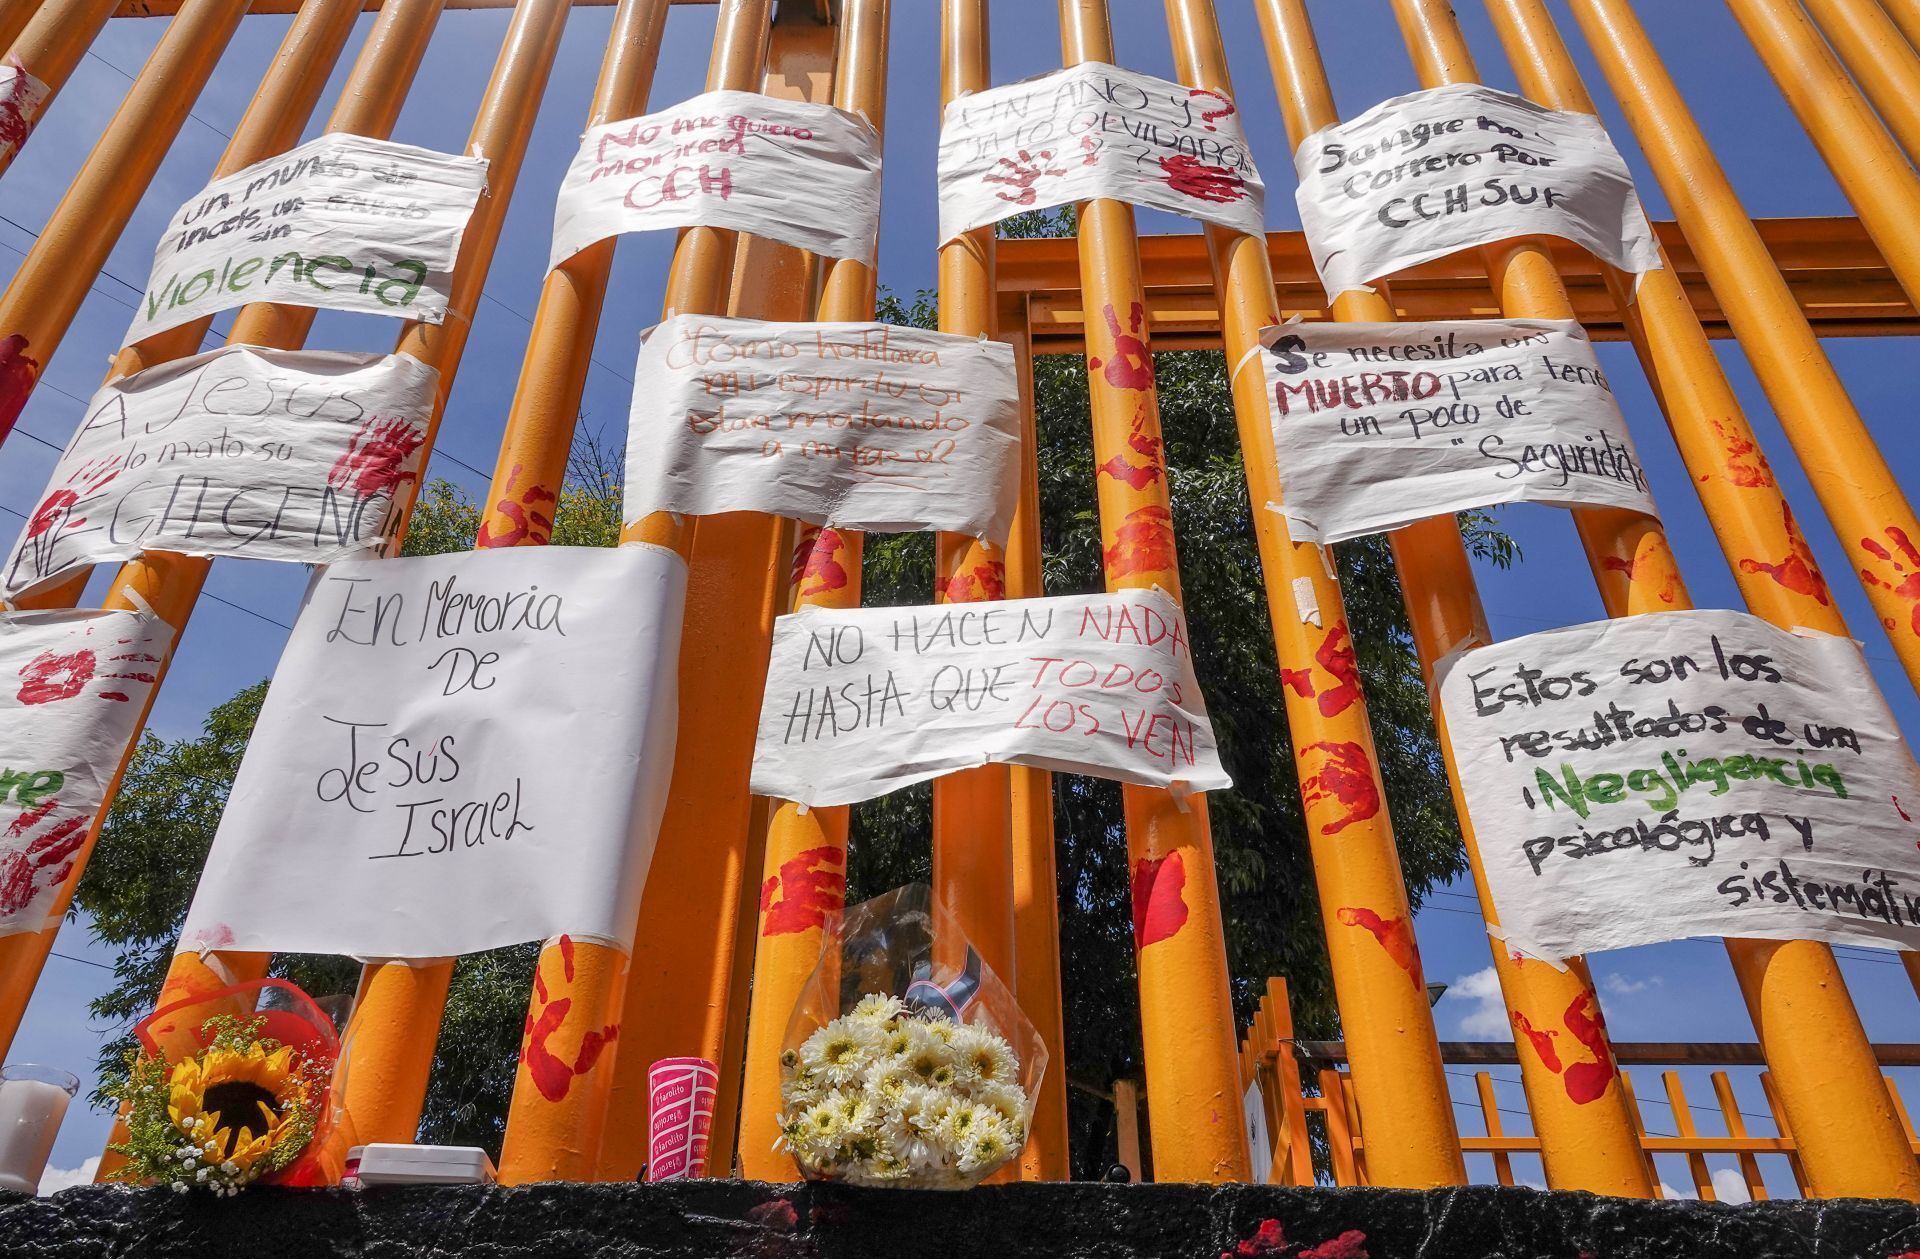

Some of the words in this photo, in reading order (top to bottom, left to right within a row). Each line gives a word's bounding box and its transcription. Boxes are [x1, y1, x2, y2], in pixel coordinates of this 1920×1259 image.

[597, 123, 662, 163] No
[671, 115, 720, 135] me
[727, 114, 813, 142] quiero
[1015, 120, 1055, 147] LO
[1067, 111, 1254, 177] OLVIDARON
[1319, 115, 1464, 174] Sangre
[242, 148, 358, 202] mundo
[623, 163, 733, 209] CCH
[1377, 183, 1469, 228] CCH
[1480, 178, 1564, 208] Sur
[248, 224, 292, 242] sin
[1270, 334, 1332, 375] Se
[1347, 332, 1484, 364] necesita
[703, 370, 756, 400] mi
[779, 370, 909, 404] espiritu
[919, 381, 961, 407] si
[1275, 369, 1442, 416] MUERTO
[1439, 364, 1523, 401] para
[65, 392, 126, 460] A
[786, 399, 970, 432] matando
[1340, 412, 1382, 437] un
[1497, 395, 1532, 420] de
[122, 441, 146, 472] lo
[157, 427, 244, 463] mato
[262, 440, 294, 462] su
[762, 437, 784, 459] a
[801, 438, 842, 462] mi
[853, 437, 957, 466] raza?
[326, 576, 408, 647] En
[802, 624, 864, 672] NO
[886, 607, 1053, 655] HACEN
[1079, 603, 1188, 657] NADA
[427, 646, 500, 696] De
[1467, 661, 1598, 718] Estos
[1619, 653, 1700, 684] son
[1711, 633, 1783, 684] los
[782, 669, 911, 745] HASTA
[930, 661, 1020, 712] QUE
[1026, 656, 1183, 705] TODOS
[1014, 694, 1100, 736] LOS
[1120, 709, 1196, 768] VEN
[1499, 698, 1731, 763] resultados
[1741, 702, 1794, 746] de
[1804, 722, 1863, 755] una
[1521, 808, 1771, 876] psicológica
[1784, 812, 1813, 852] y
[659, 1084, 685, 1102] farolito
[653, 1111, 678, 1131] farolito
[658, 1132, 684, 1152] farolito
